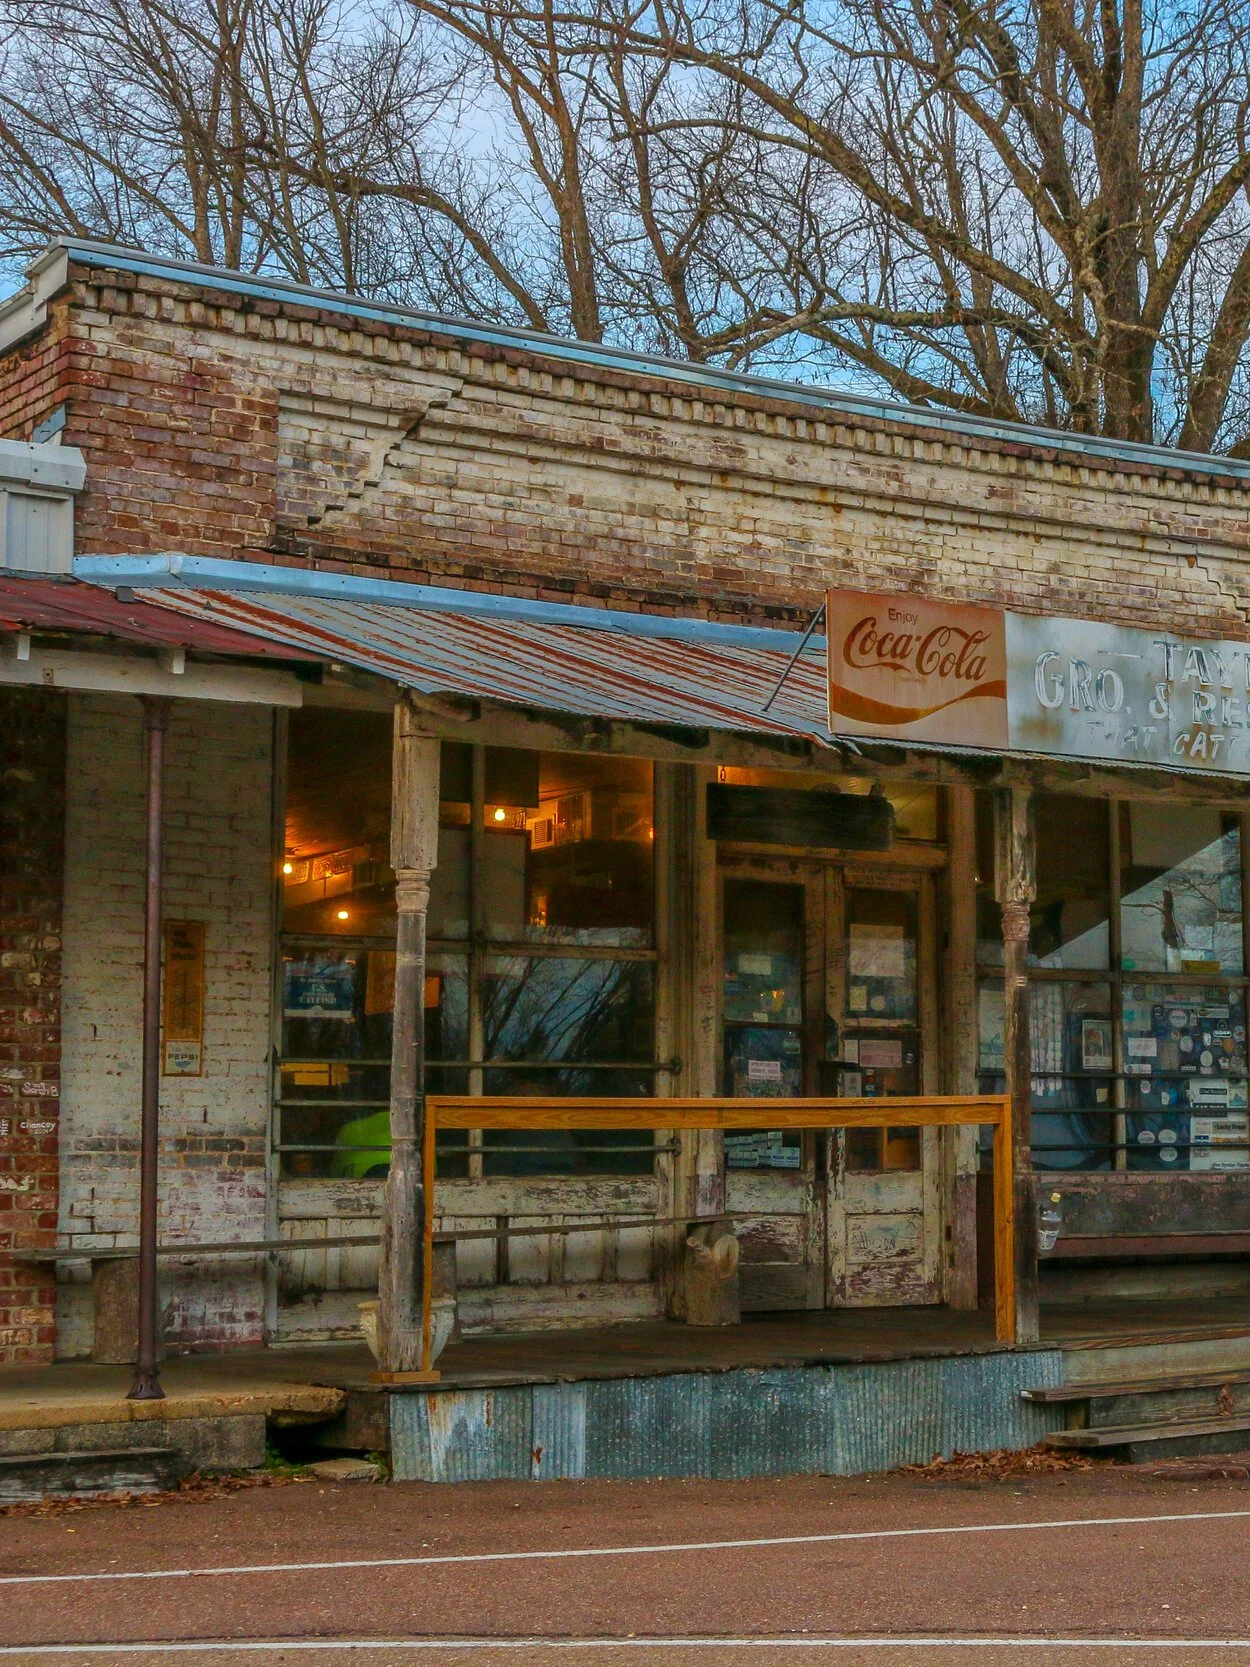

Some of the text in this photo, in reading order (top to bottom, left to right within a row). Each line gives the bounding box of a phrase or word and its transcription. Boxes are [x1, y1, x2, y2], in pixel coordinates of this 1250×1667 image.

[888, 608, 918, 625] Enjoy
[843, 616, 992, 681] Coca-Cola
[1034, 650, 1133, 714] GRO.
[1149, 682, 1178, 721] &
[168, 1053, 198, 1061] PEPSI
